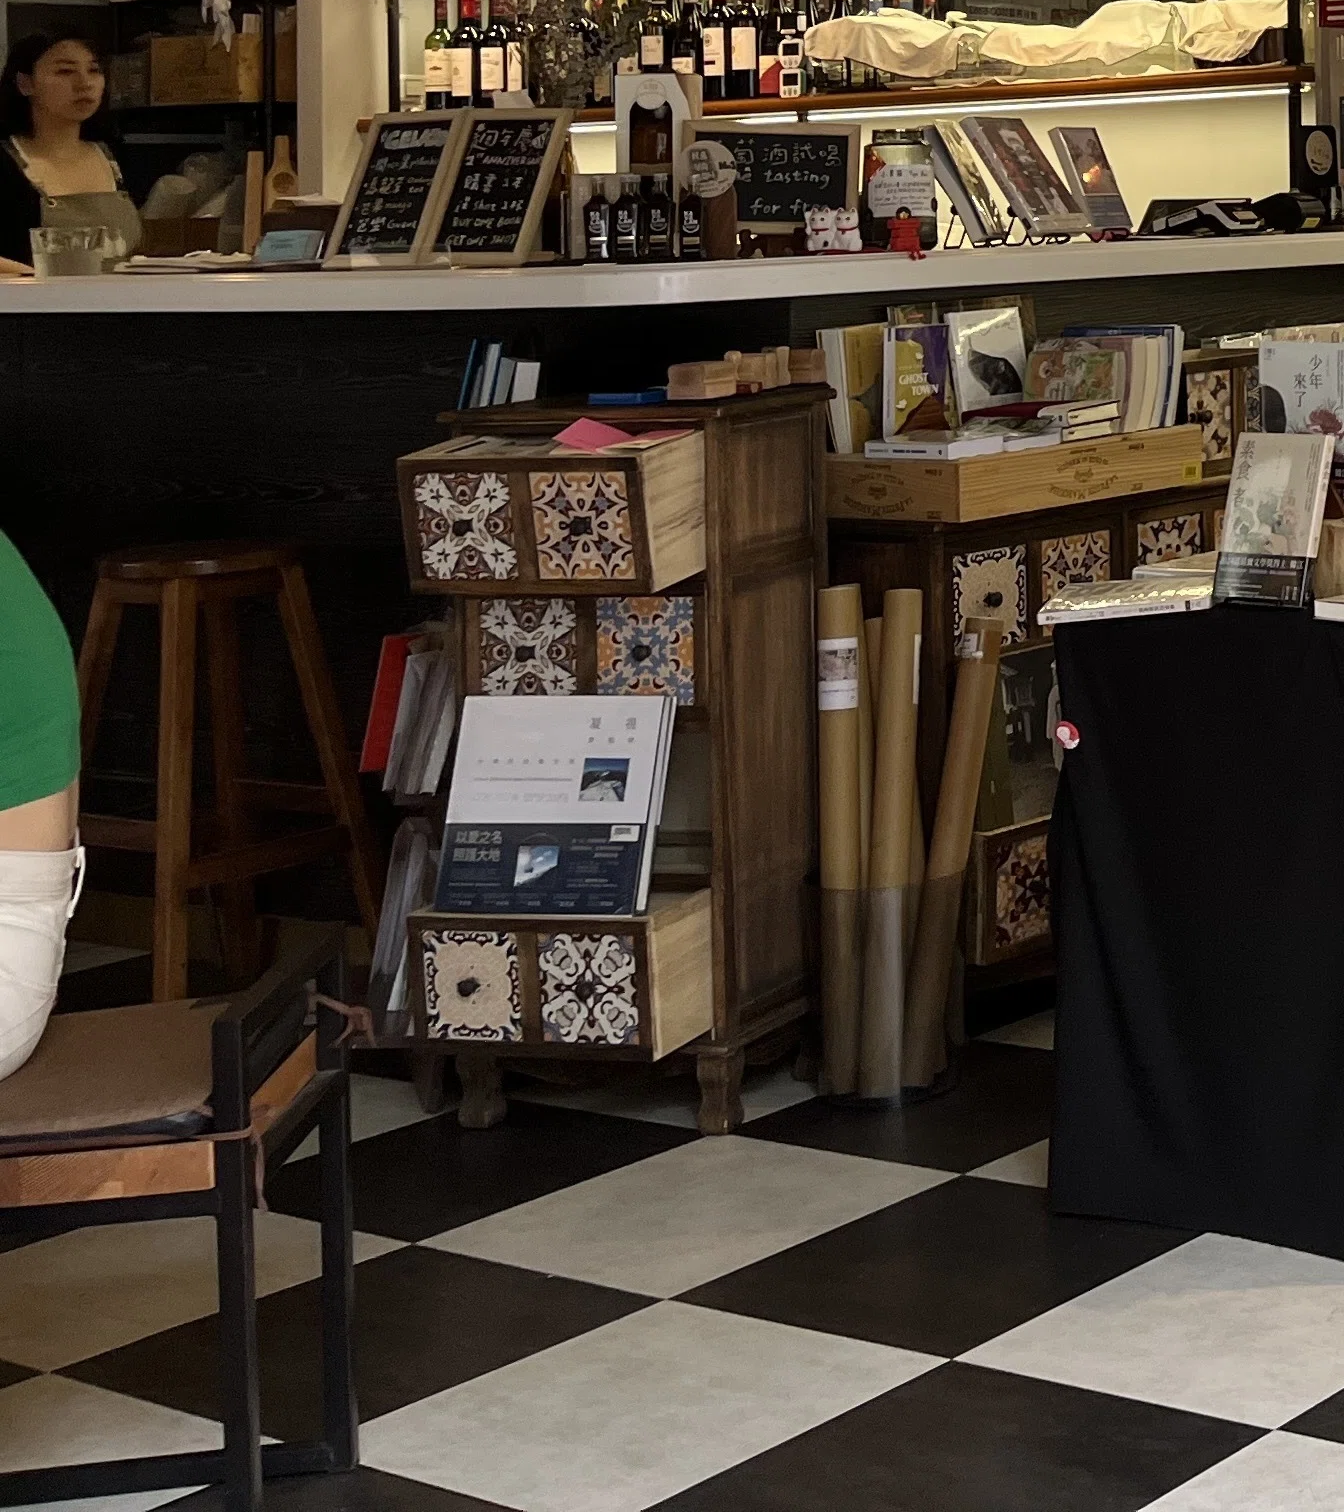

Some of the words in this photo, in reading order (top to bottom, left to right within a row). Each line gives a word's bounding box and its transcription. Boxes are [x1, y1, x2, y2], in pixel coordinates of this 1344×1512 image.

[718, 140, 843, 168] 萄酒試喝
[764, 170, 830, 189] tasting
[750, 199, 780, 216] for
[898, 372, 929, 386] GHOST
[1308, 353, 1325, 390] 少年
[910, 382, 940, 396] TOWN
[1292, 372, 1308, 408] 來了
